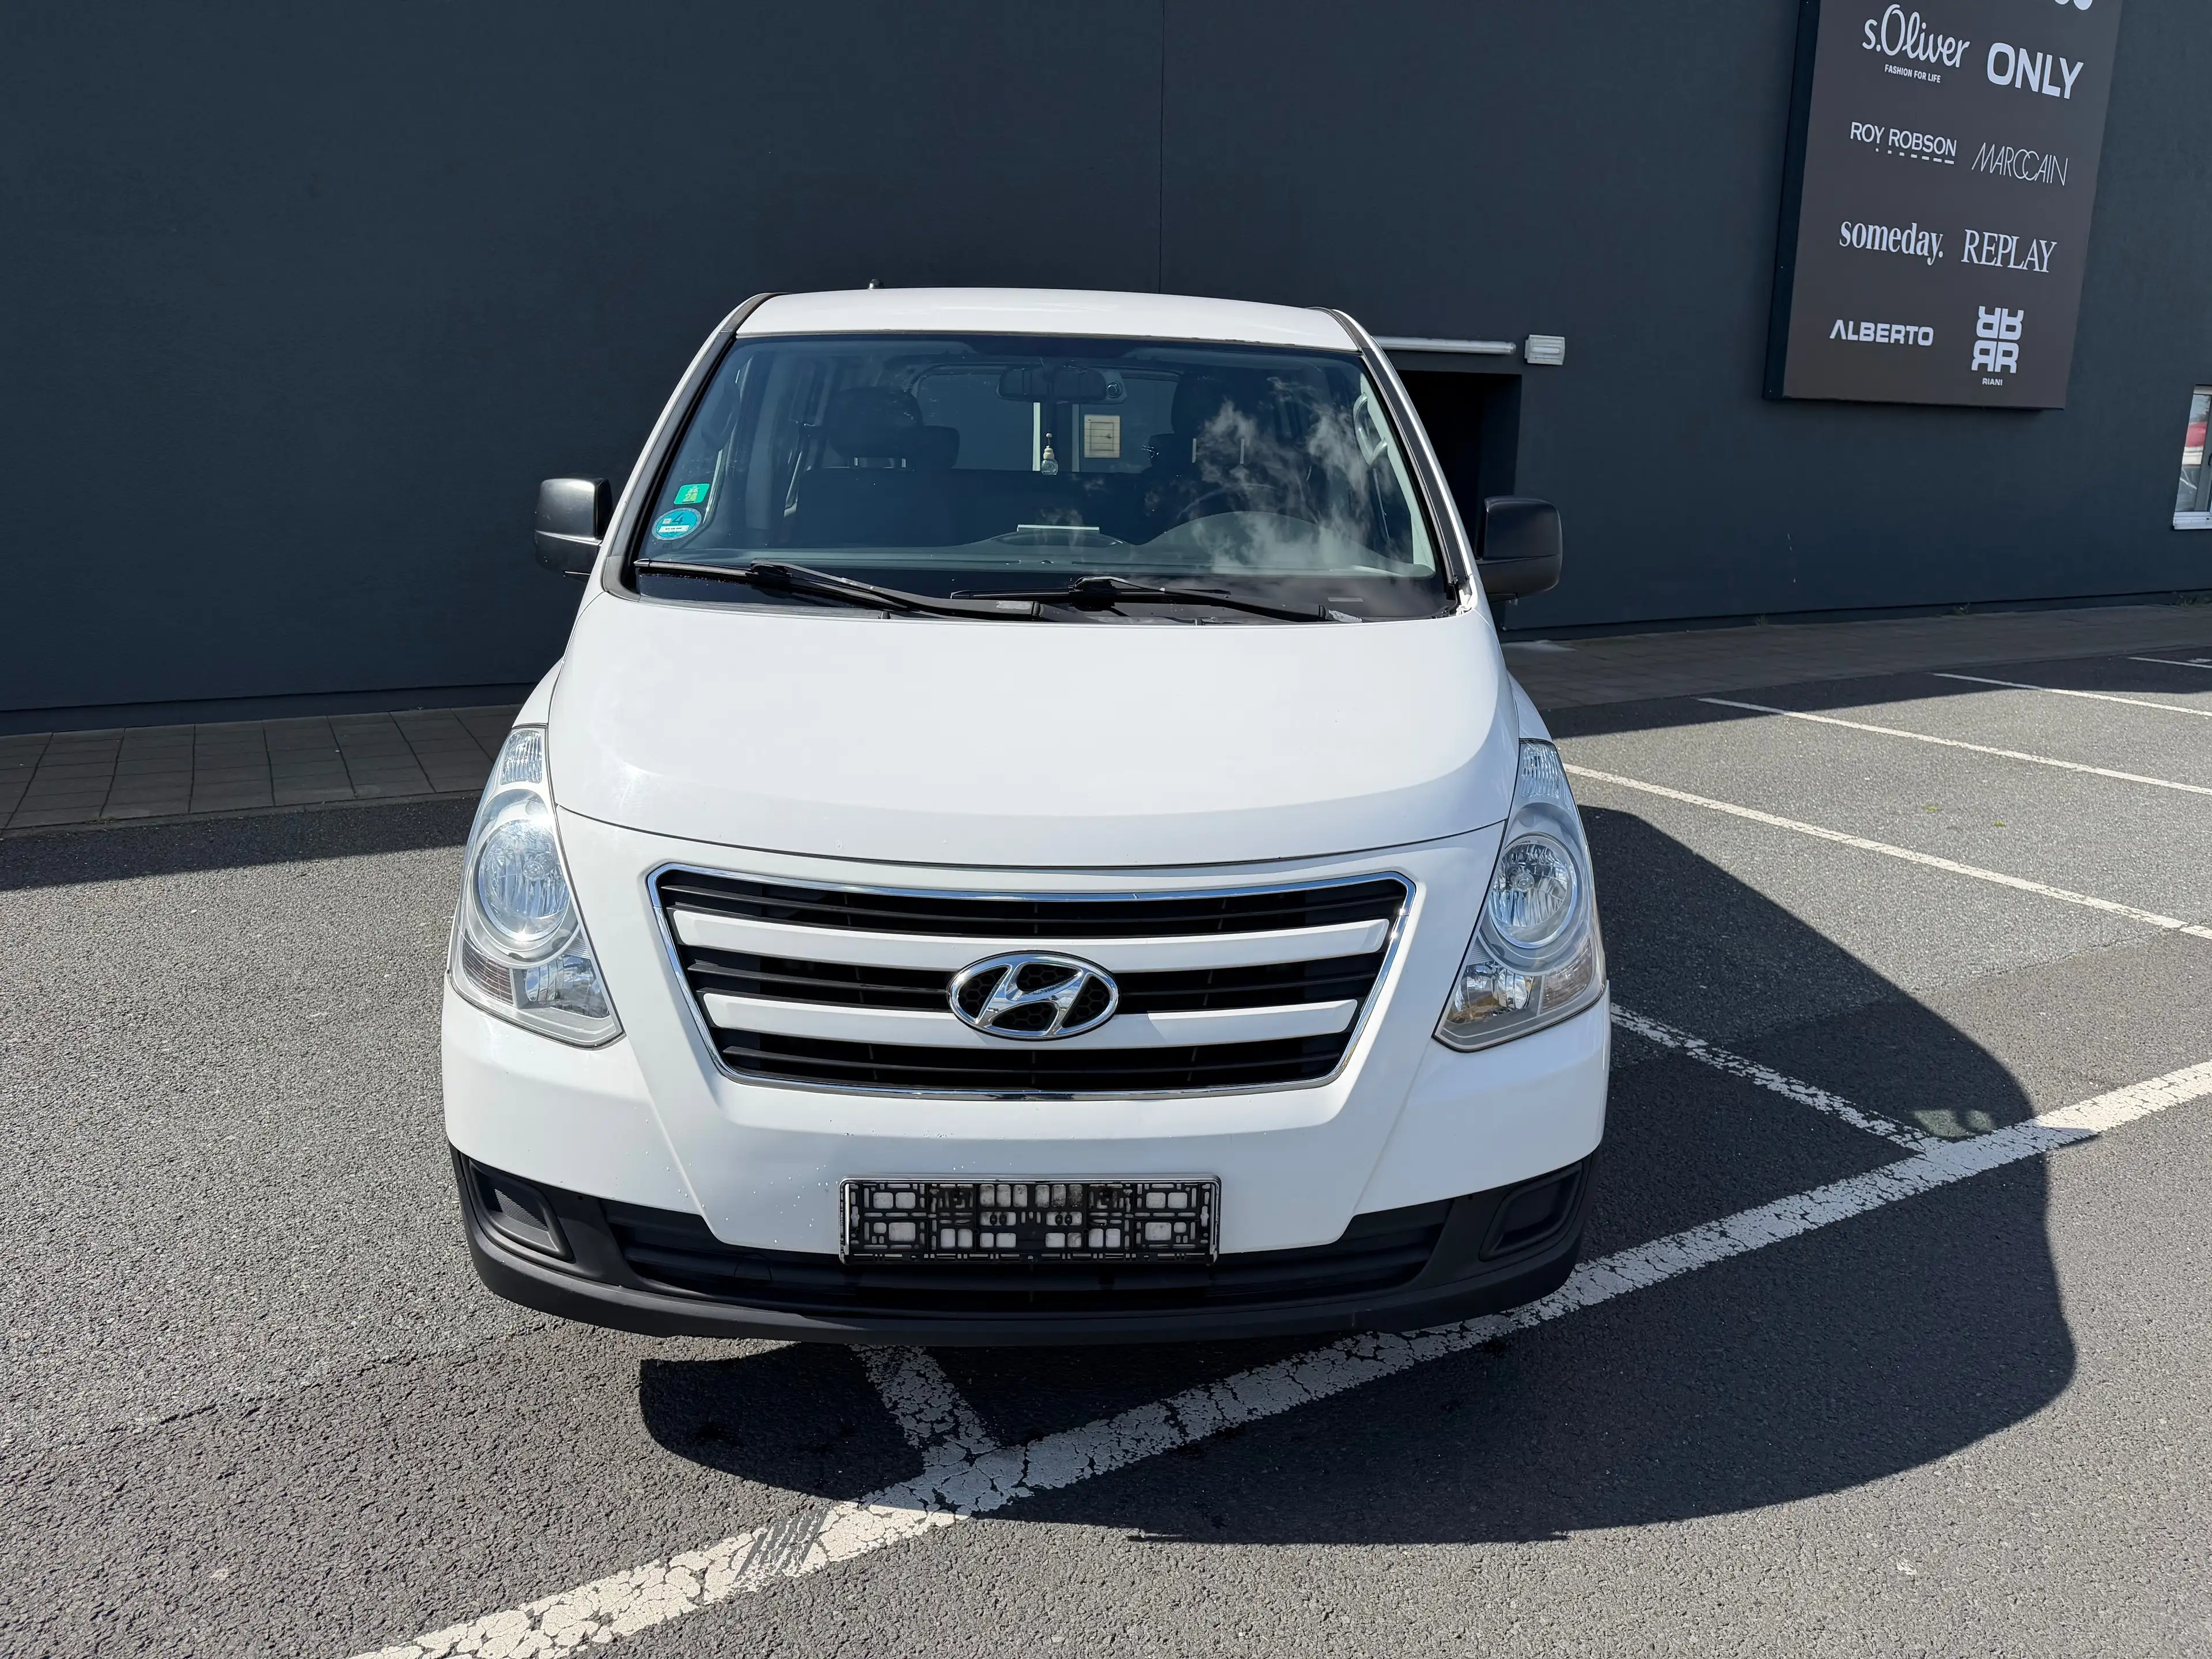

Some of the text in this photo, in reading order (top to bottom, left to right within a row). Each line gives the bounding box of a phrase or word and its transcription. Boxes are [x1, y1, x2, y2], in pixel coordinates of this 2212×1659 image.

[1862, 3, 1971, 68] s.Oliver
[1884, 64, 1941, 84] FASHION FOR LIFE
[1987, 42, 2084, 100] ONLY
[1850, 122, 1957, 157] ROY ROBSON
[1839, 221, 1944, 266] someday.
[1961, 229, 2058, 273] REPLAY
[1829, 319, 1934, 346] ALBERTO
[1982, 377, 2003, 386] RIANI
[672, 512, 685, 525] 4
